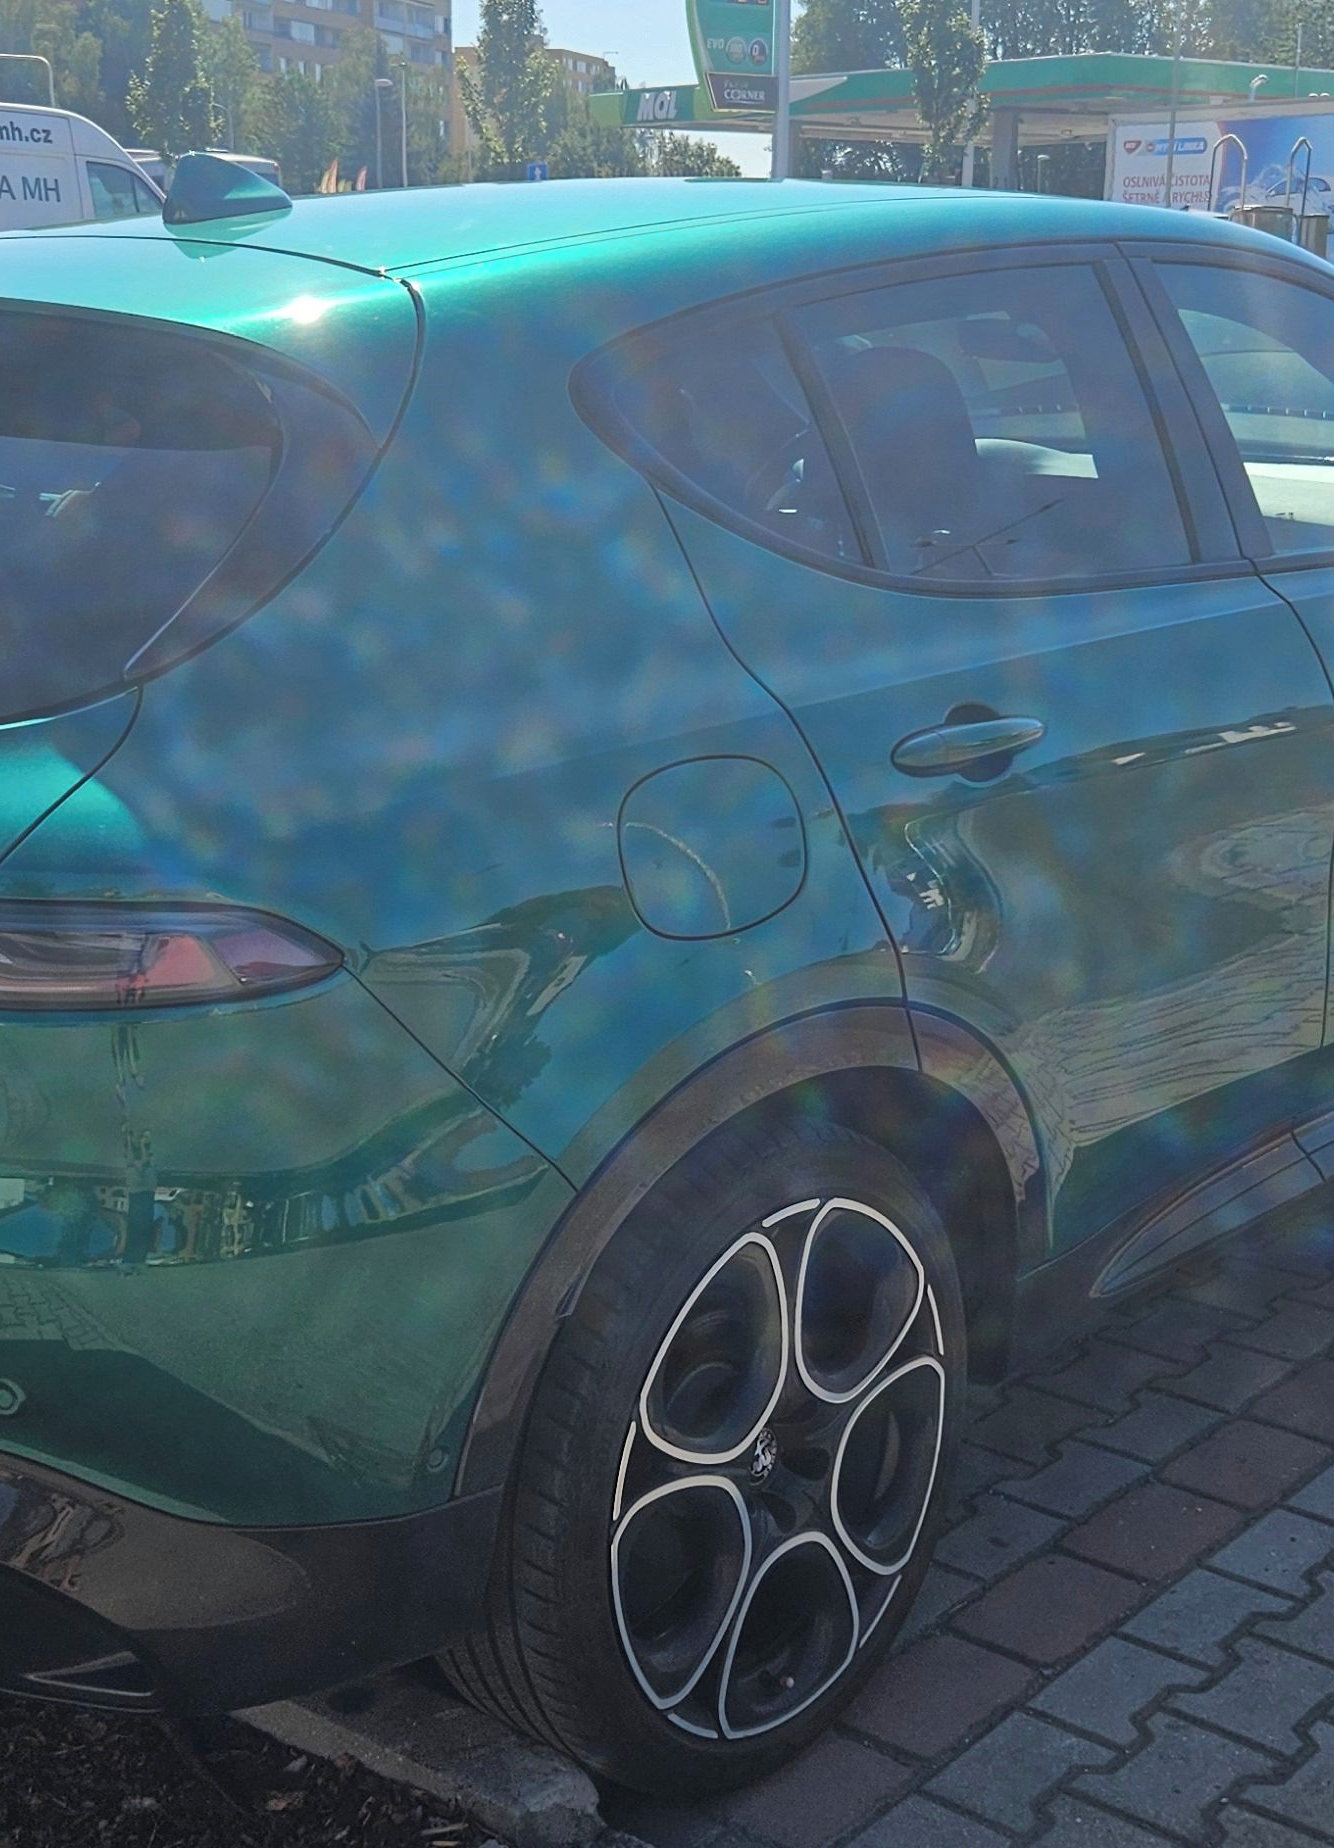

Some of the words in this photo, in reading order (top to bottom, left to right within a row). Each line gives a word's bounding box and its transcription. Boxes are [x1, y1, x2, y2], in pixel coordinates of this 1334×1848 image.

[706, 38, 724, 49] EVO
[724, 89, 766, 100] CORNER
[637, 90, 677, 121] MOL
[21, 175, 61, 203] MH
